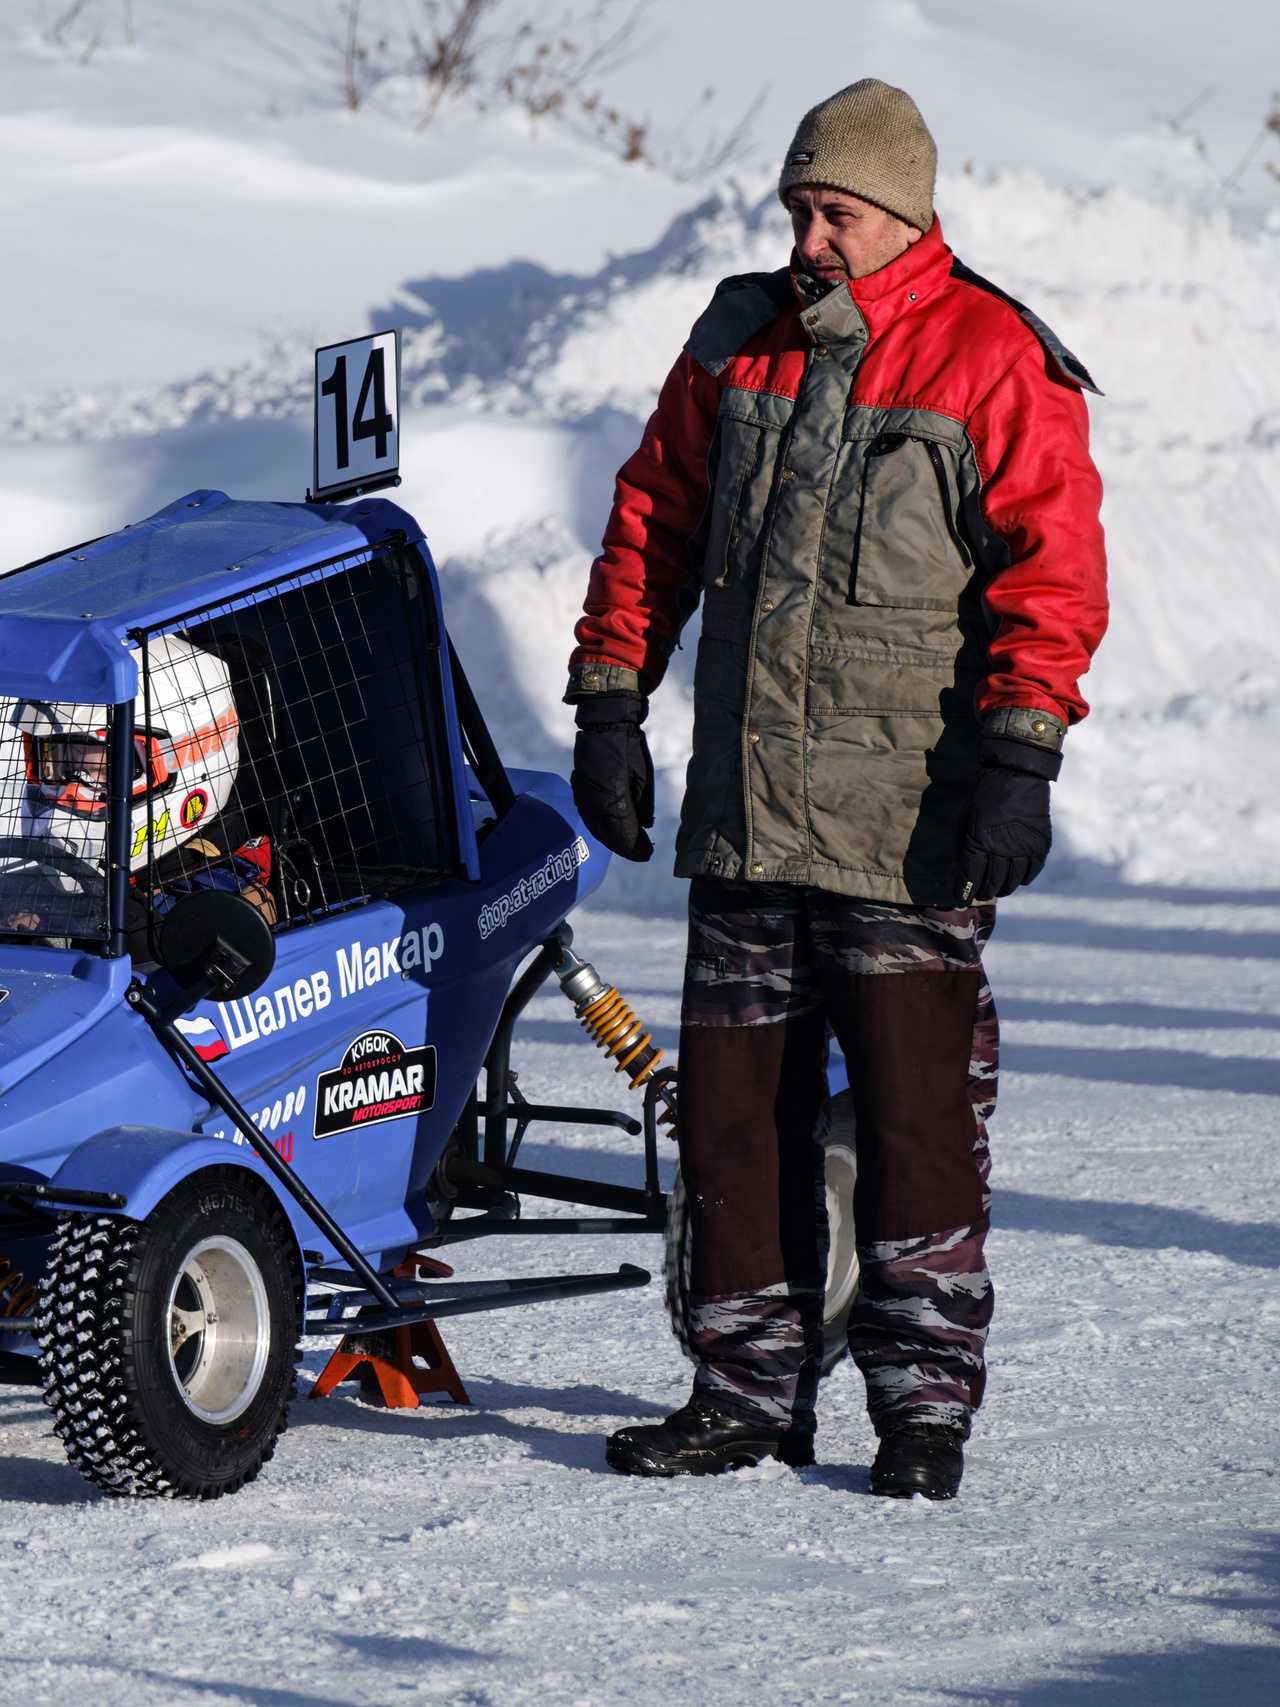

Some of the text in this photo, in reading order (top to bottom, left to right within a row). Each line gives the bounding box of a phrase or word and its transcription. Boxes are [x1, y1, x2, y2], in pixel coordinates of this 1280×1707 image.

[322, 347, 392, 469] 14
[478, 836, 589, 939] shop.at-racing.ru
[217, 922, 444, 1050] Шалев Макар
[351, 1035, 390, 1063] КУБОК
[323, 1064, 425, 1116] KRAMAR
[351, 1094, 425, 1123] MOTORSPORT
